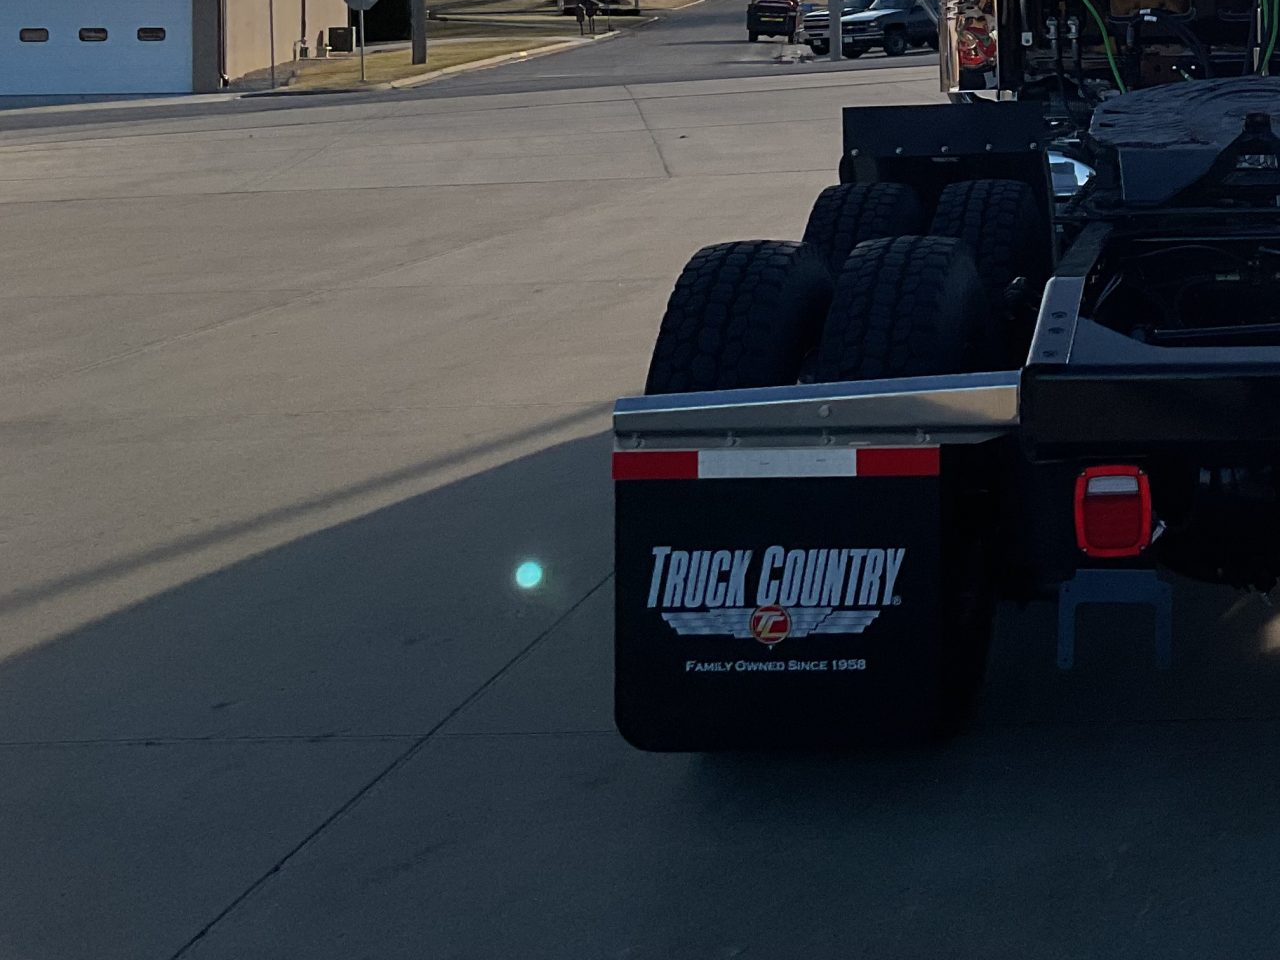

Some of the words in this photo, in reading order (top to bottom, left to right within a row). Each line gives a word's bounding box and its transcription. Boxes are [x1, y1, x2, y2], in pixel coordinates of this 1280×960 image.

[647, 546, 752, 608] TRUCK
[756, 545, 906, 607] COUNTRY
[685, 659, 733, 672] FAMILY
[734, 659, 786, 672] OWNED
[787, 659, 828, 671] SINCE
[831, 658, 867, 671] 1958
